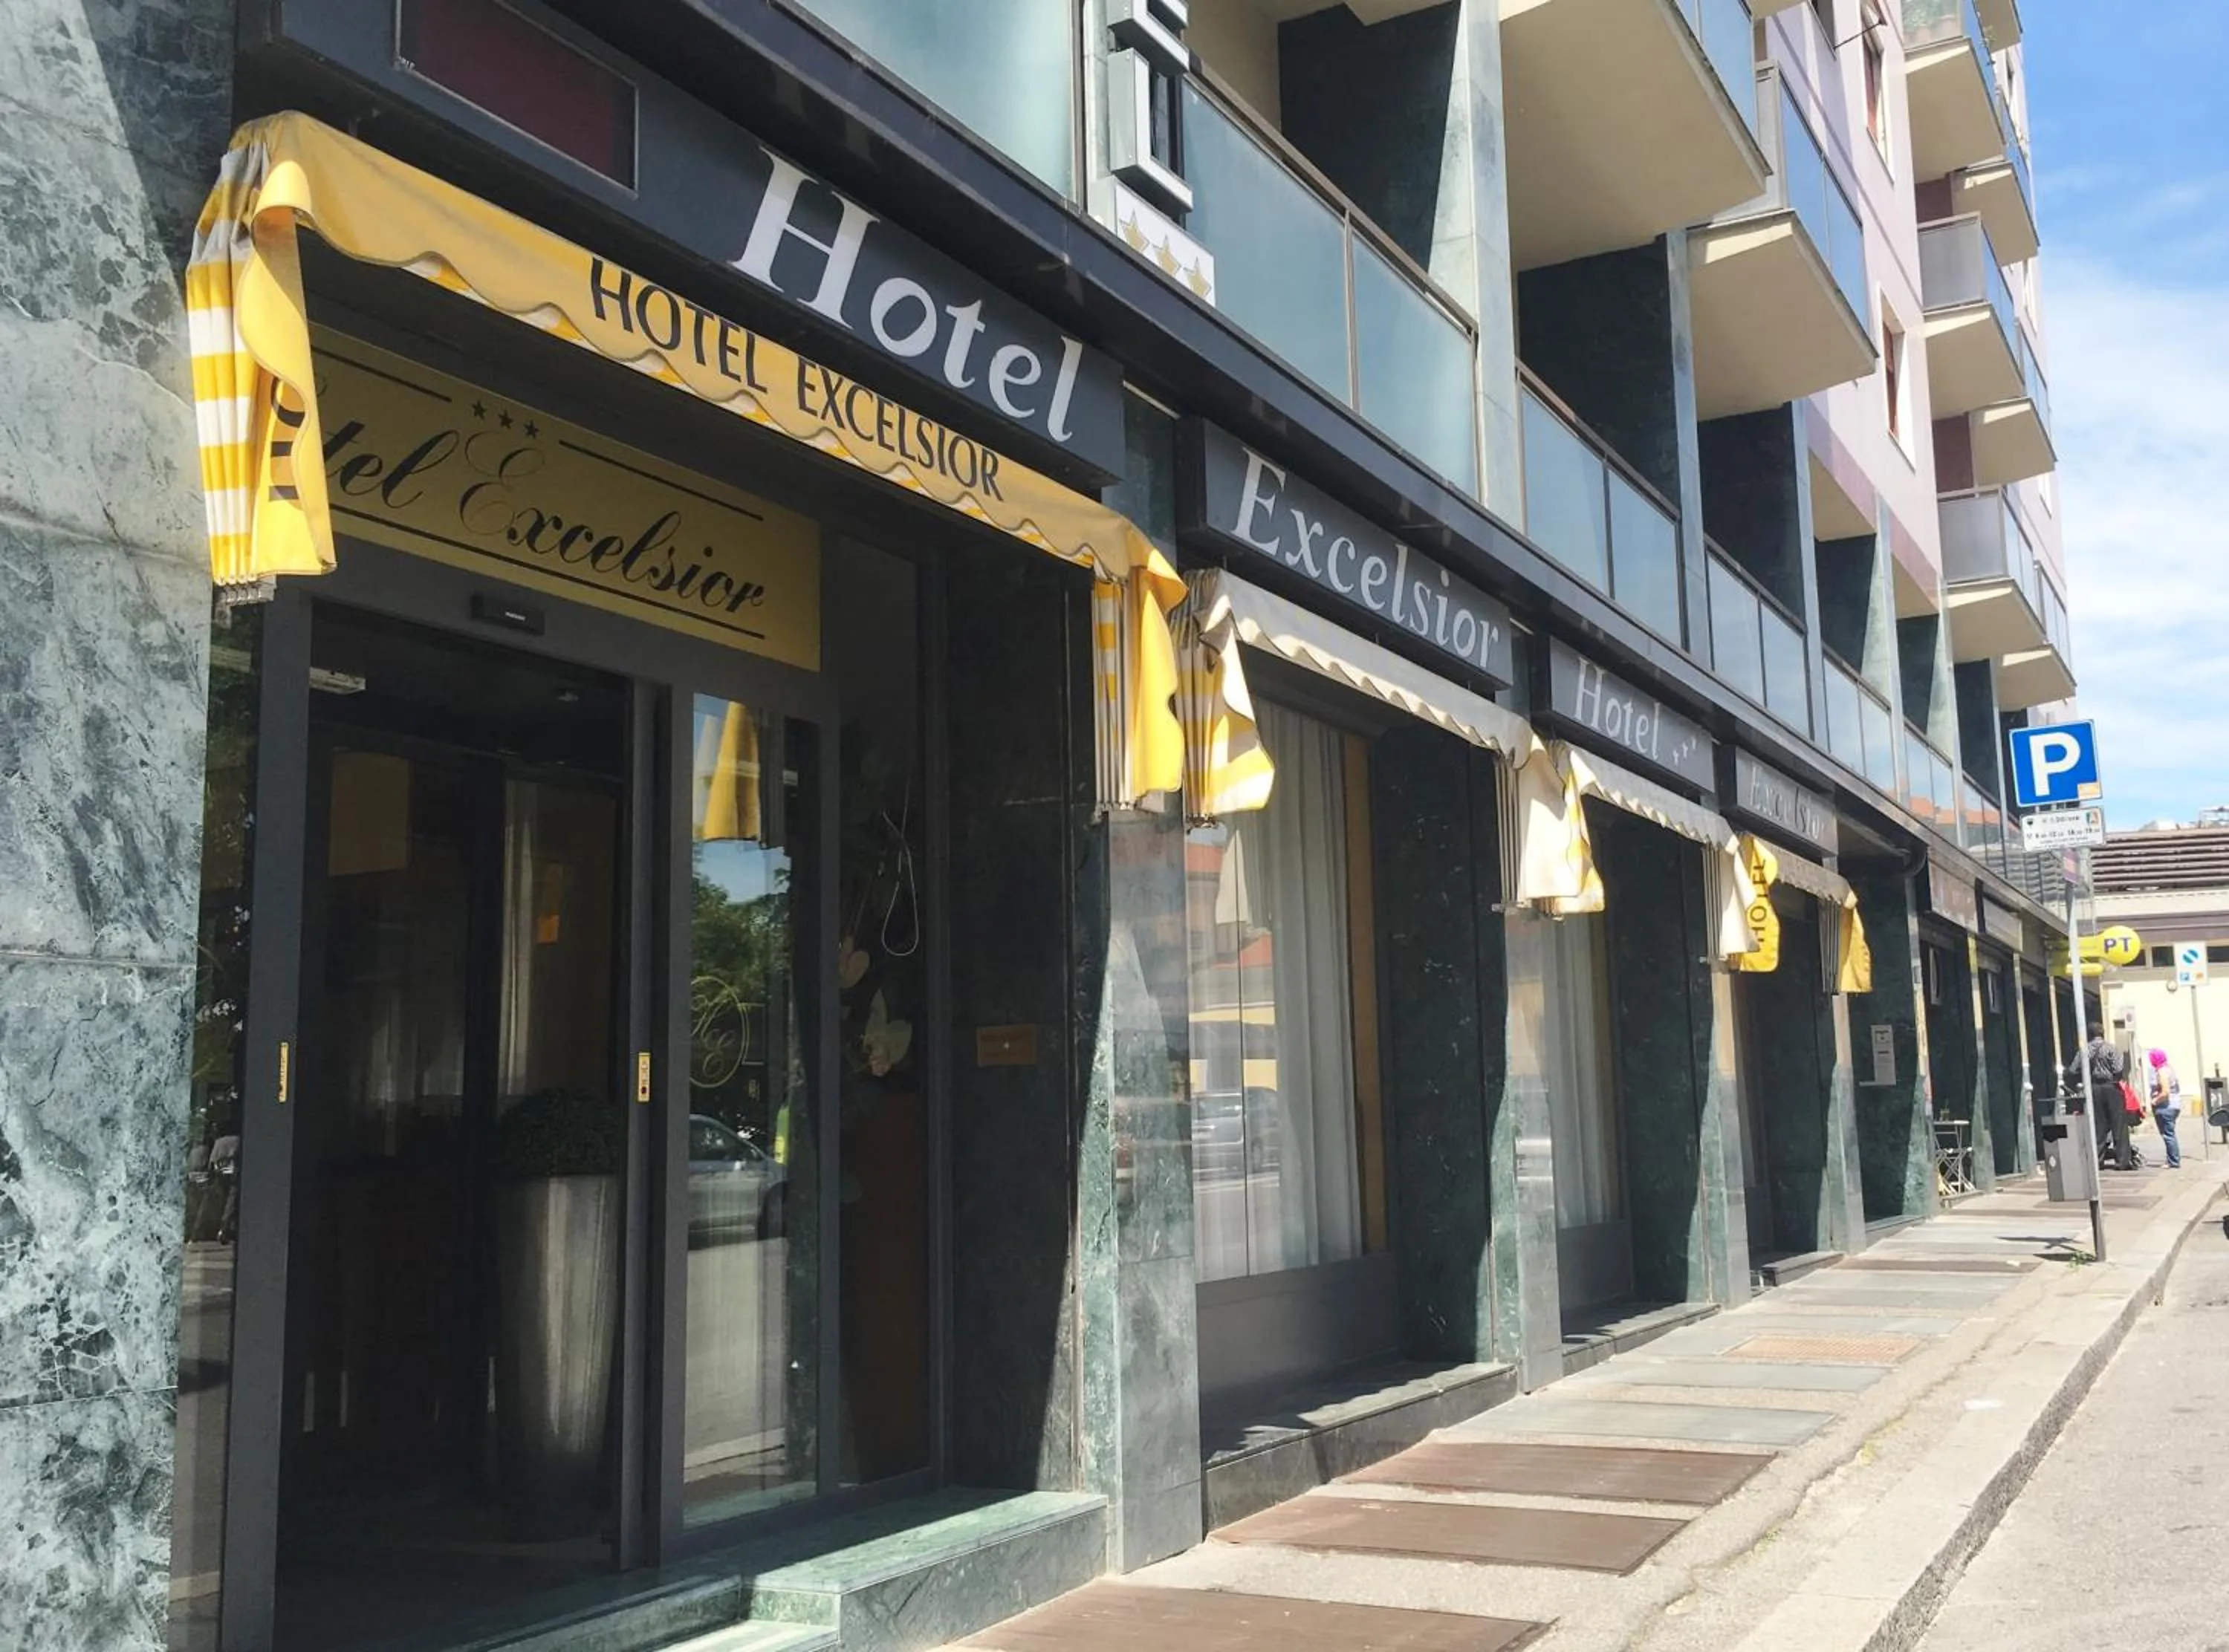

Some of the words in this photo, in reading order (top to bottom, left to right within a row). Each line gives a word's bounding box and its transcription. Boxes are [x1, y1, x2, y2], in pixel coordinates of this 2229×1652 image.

[589, 256, 768, 394] HOTEL
[797, 355, 1004, 502] EXCELSIOR
[730, 146, 1084, 443] Hotel
[322, 419, 460, 510] tel
[458, 429, 766, 614] Excelsior
[1230, 446, 1499, 669] Excelsior
[1574, 657, 1661, 761] Hotel
[2028, 732, 2080, 797] P
[2103, 937, 2132, 953] PT
